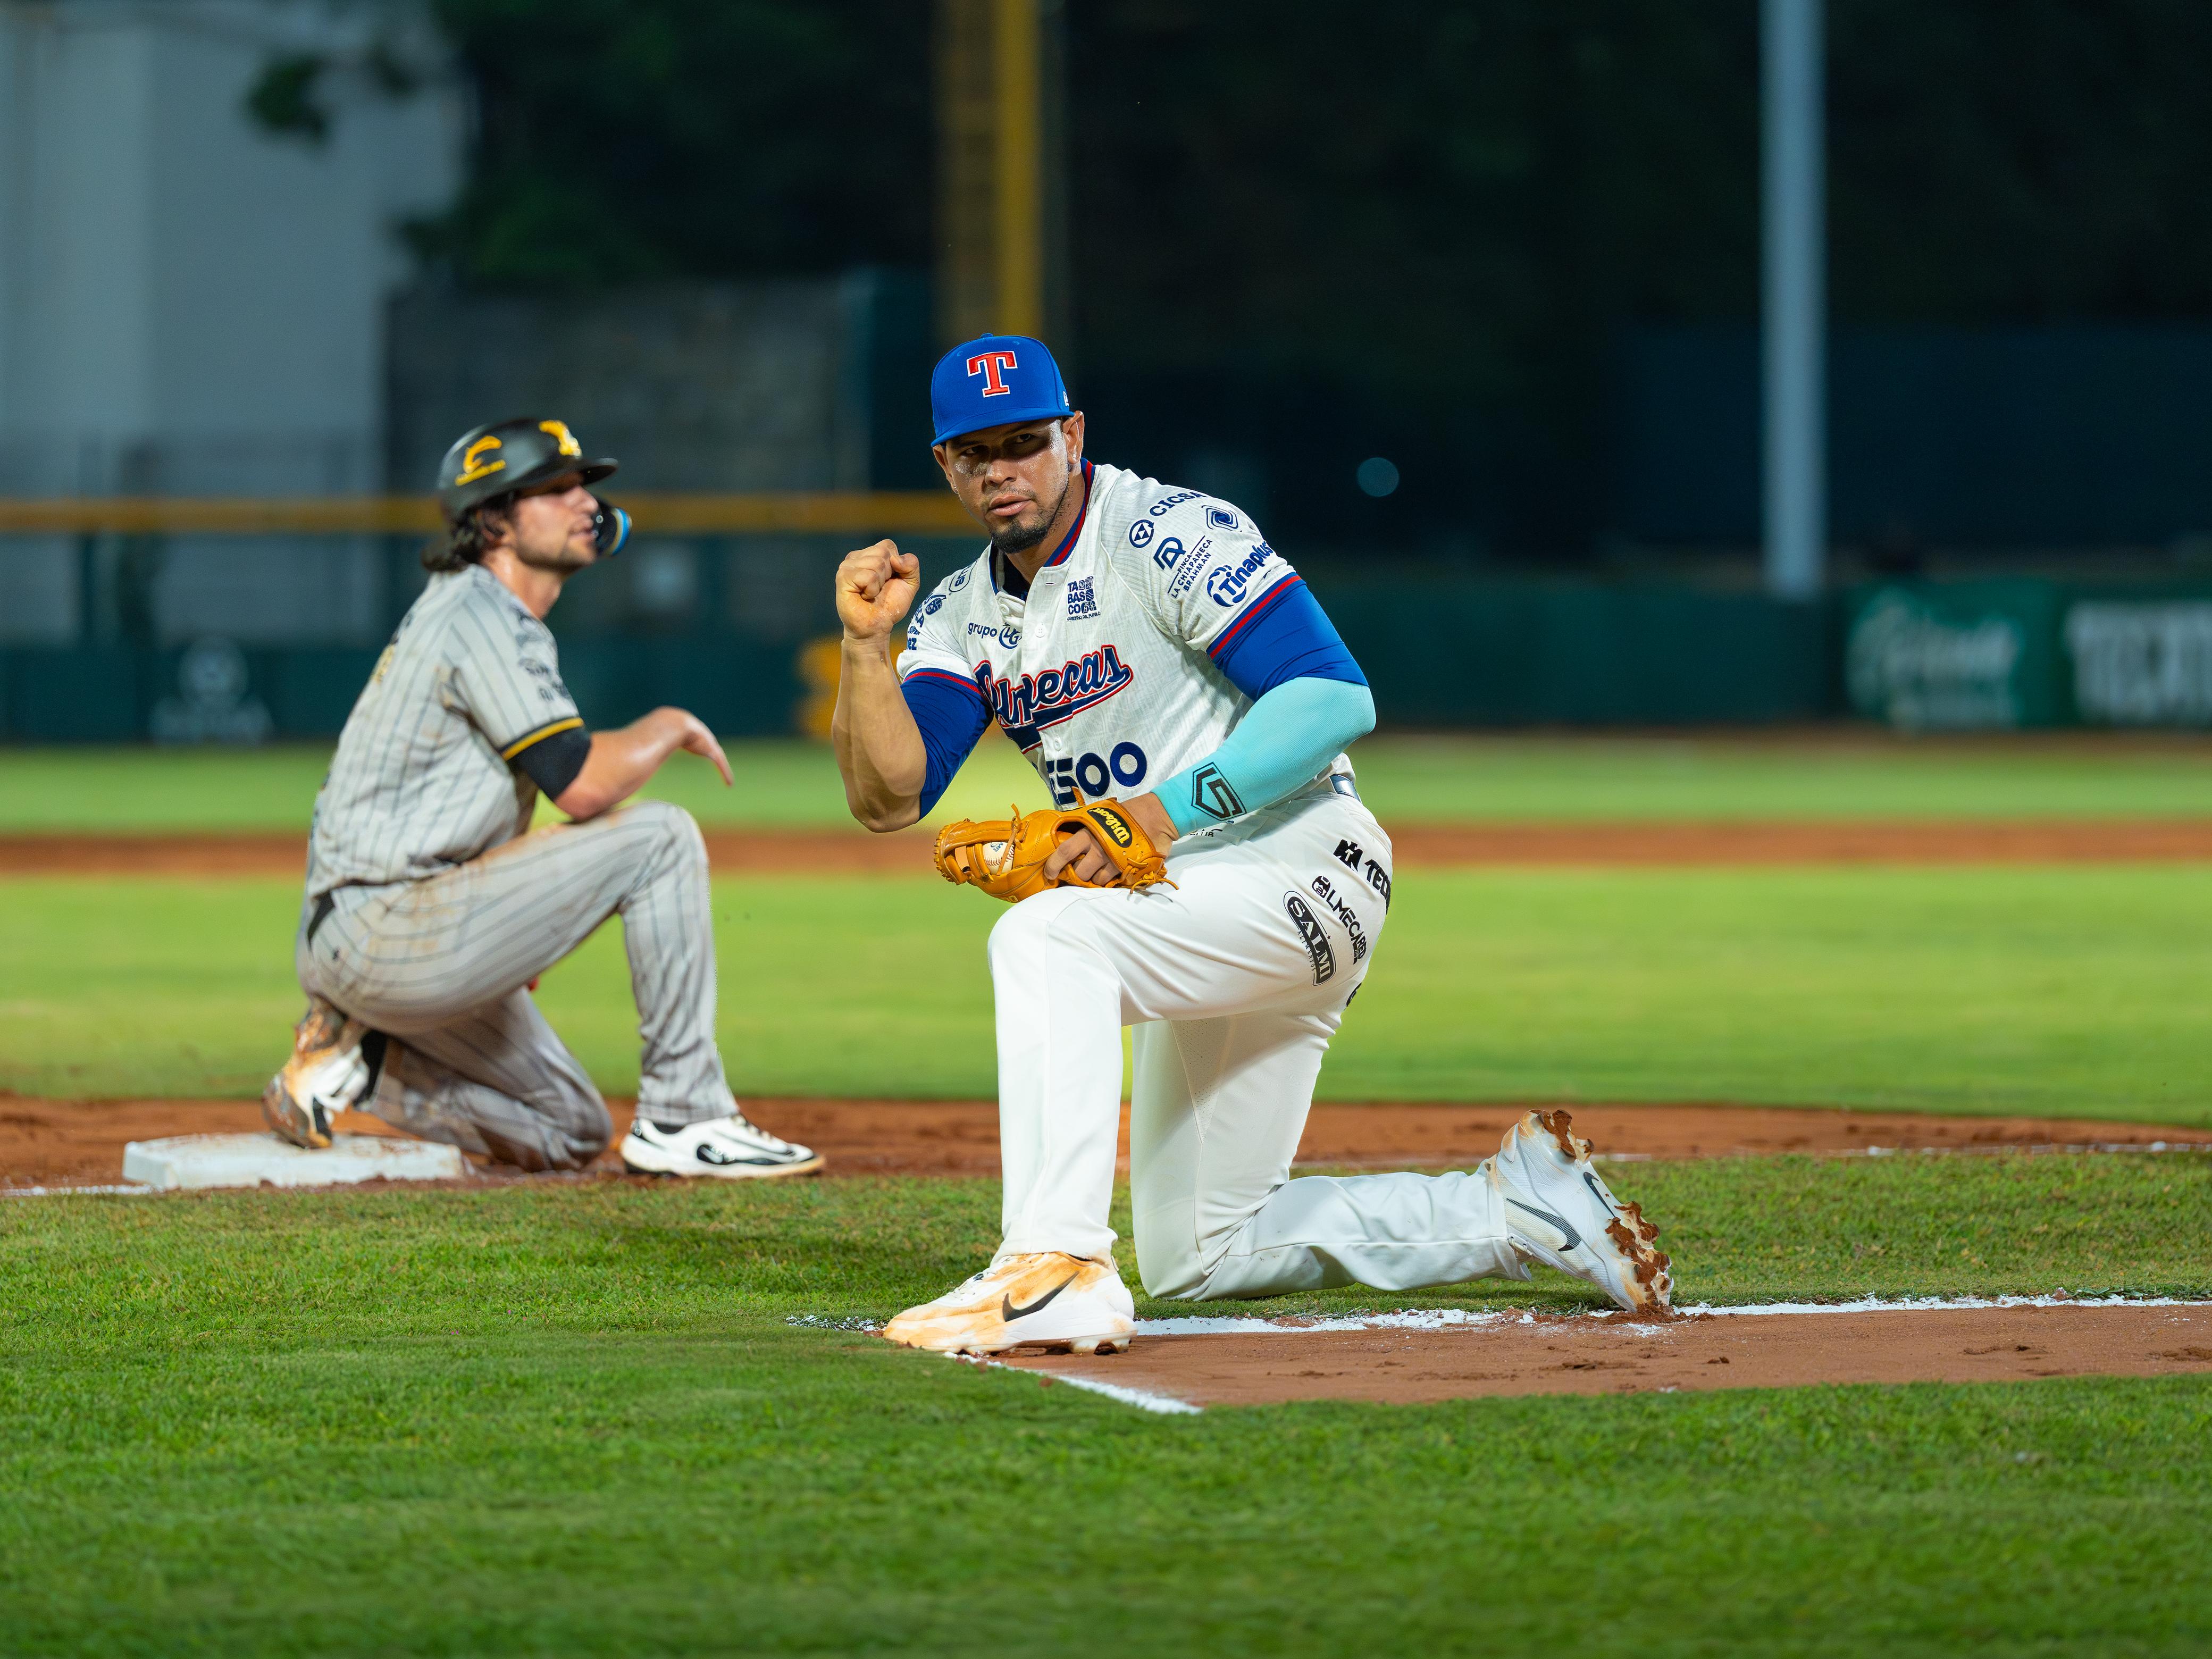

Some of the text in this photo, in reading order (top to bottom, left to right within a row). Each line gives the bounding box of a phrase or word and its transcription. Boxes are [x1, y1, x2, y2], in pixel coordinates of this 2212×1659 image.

[967, 350, 1018, 398] T
[1149, 491, 1208, 516] CICSA
[1171, 539, 1213, 599] LA CHIAPANECA
[1177, 554, 1192, 573] FINCA
[1183, 552, 1211, 591] BRAHMAN
[1068, 591, 1086, 604] BAS
[1068, 603, 1081, 615] CO
[968, 622, 998, 639] grupo
[1088, 808, 1130, 844] Wilson
[1289, 900, 1331, 979] SALMI
[1297, 931, 1317, 972] ALIMENTOS
